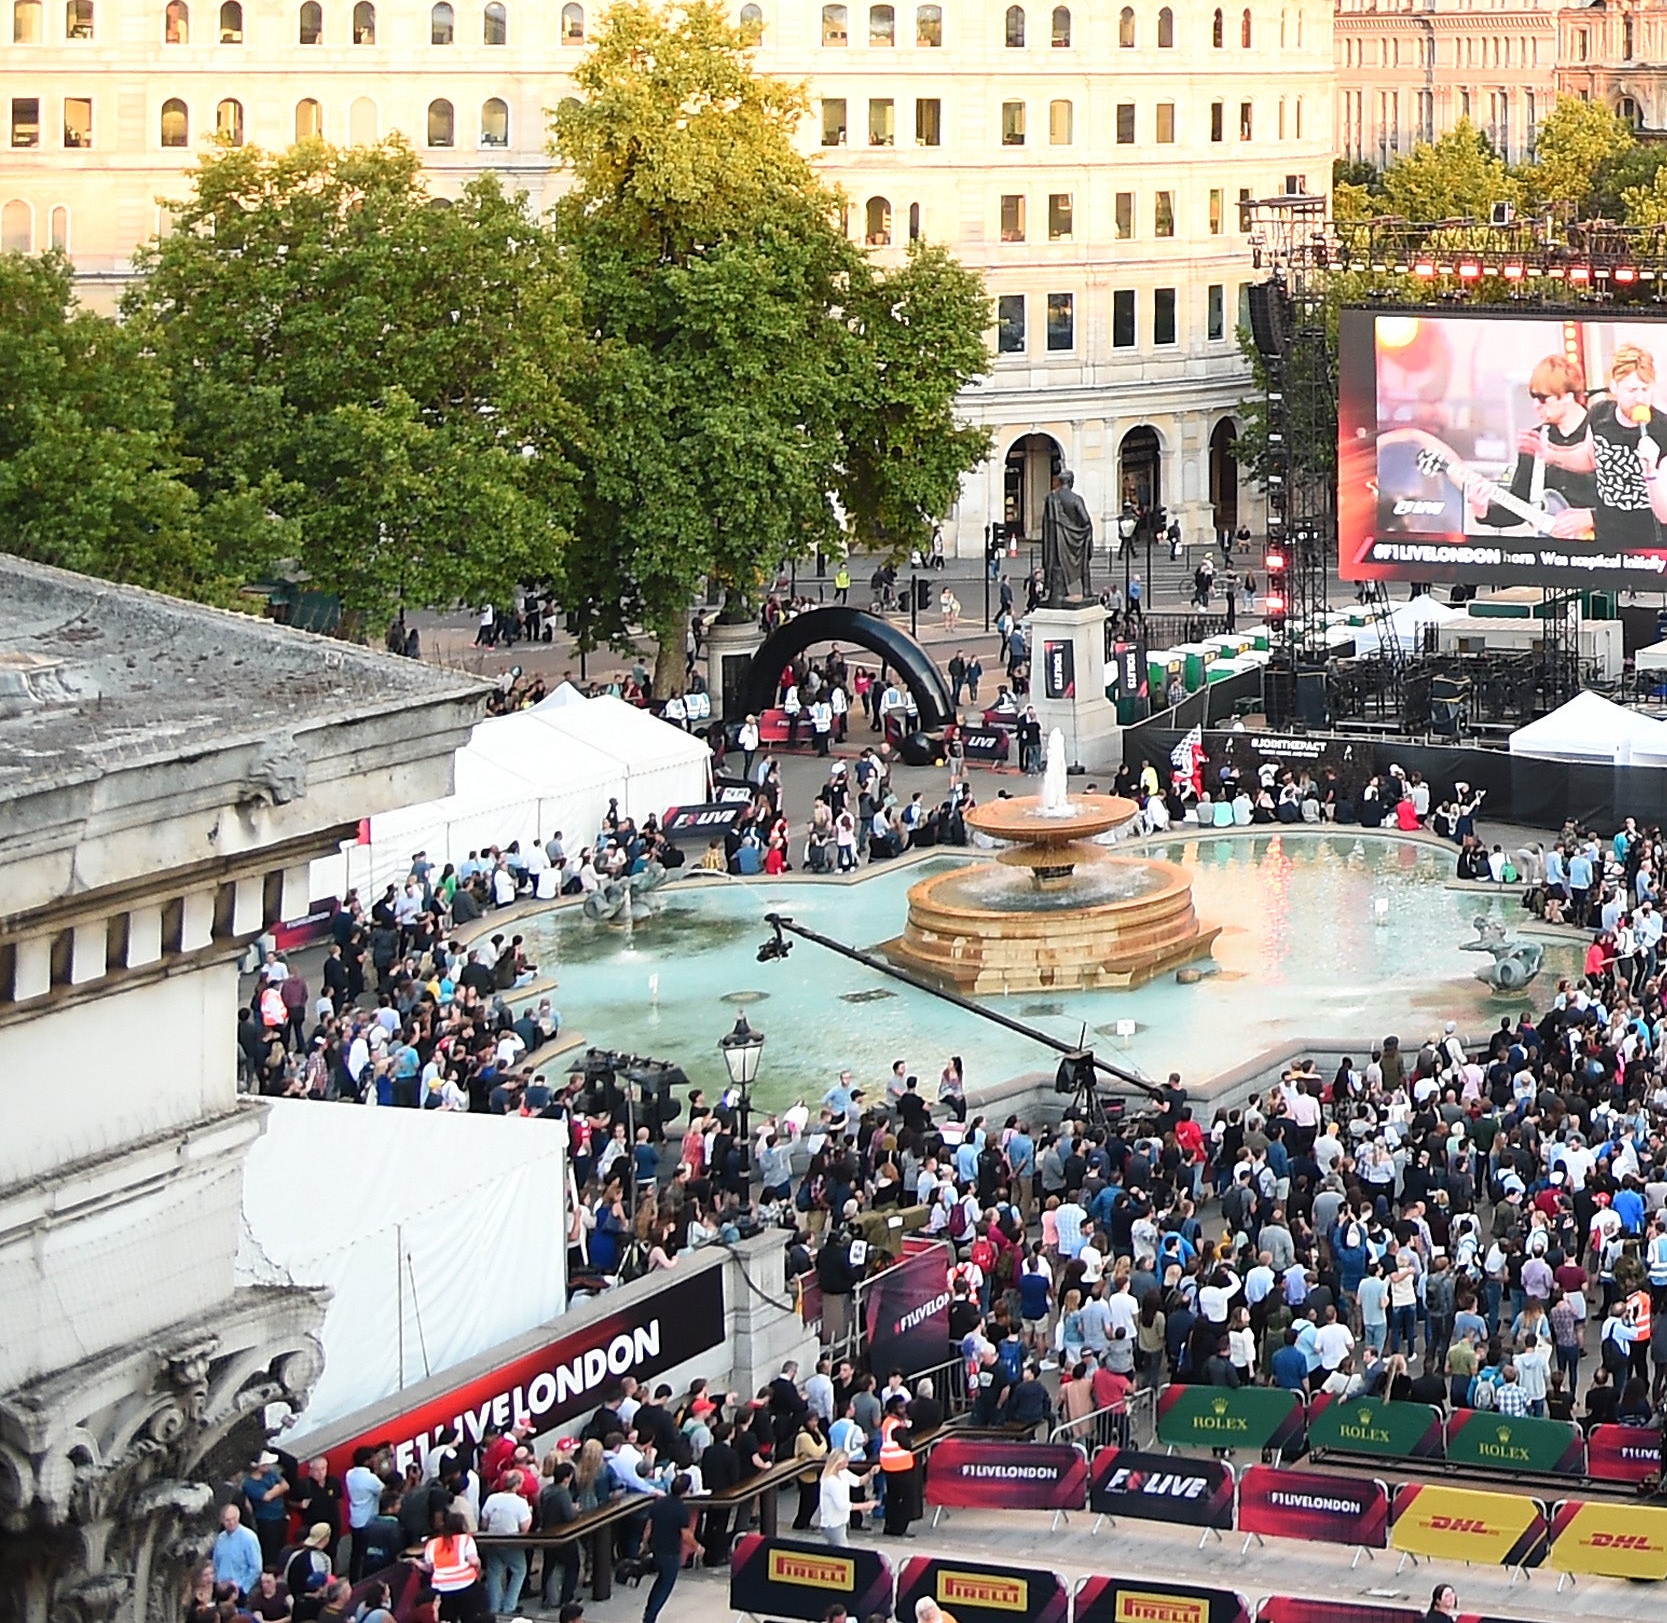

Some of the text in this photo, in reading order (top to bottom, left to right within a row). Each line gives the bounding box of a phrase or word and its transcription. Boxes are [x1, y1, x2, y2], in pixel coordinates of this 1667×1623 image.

[1373, 545, 1501, 566] #F1LIVELONDON
[1540, 551, 1568, 568] Was
[1623, 553, 1666, 574] initially
[1192, 1415, 1249, 1433] ROLEX
[1338, 1424, 1392, 1445] ROLEX
[1478, 1441, 1531, 1462] ROLEX
[961, 1463, 1058, 1483] F1LIVELONDON
[1144, 1475, 1208, 1501] LIVE
[1271, 1492, 1361, 1514] F1LIVELONDON
[1430, 1515, 1488, 1535] DHL
[1590, 1532, 1651, 1552] DHL
[776, 1557, 847, 1586] PIRELLI
[944, 1577, 1022, 1607] PIRELLI
[1122, 1598, 1203, 1623] PIRELLI
